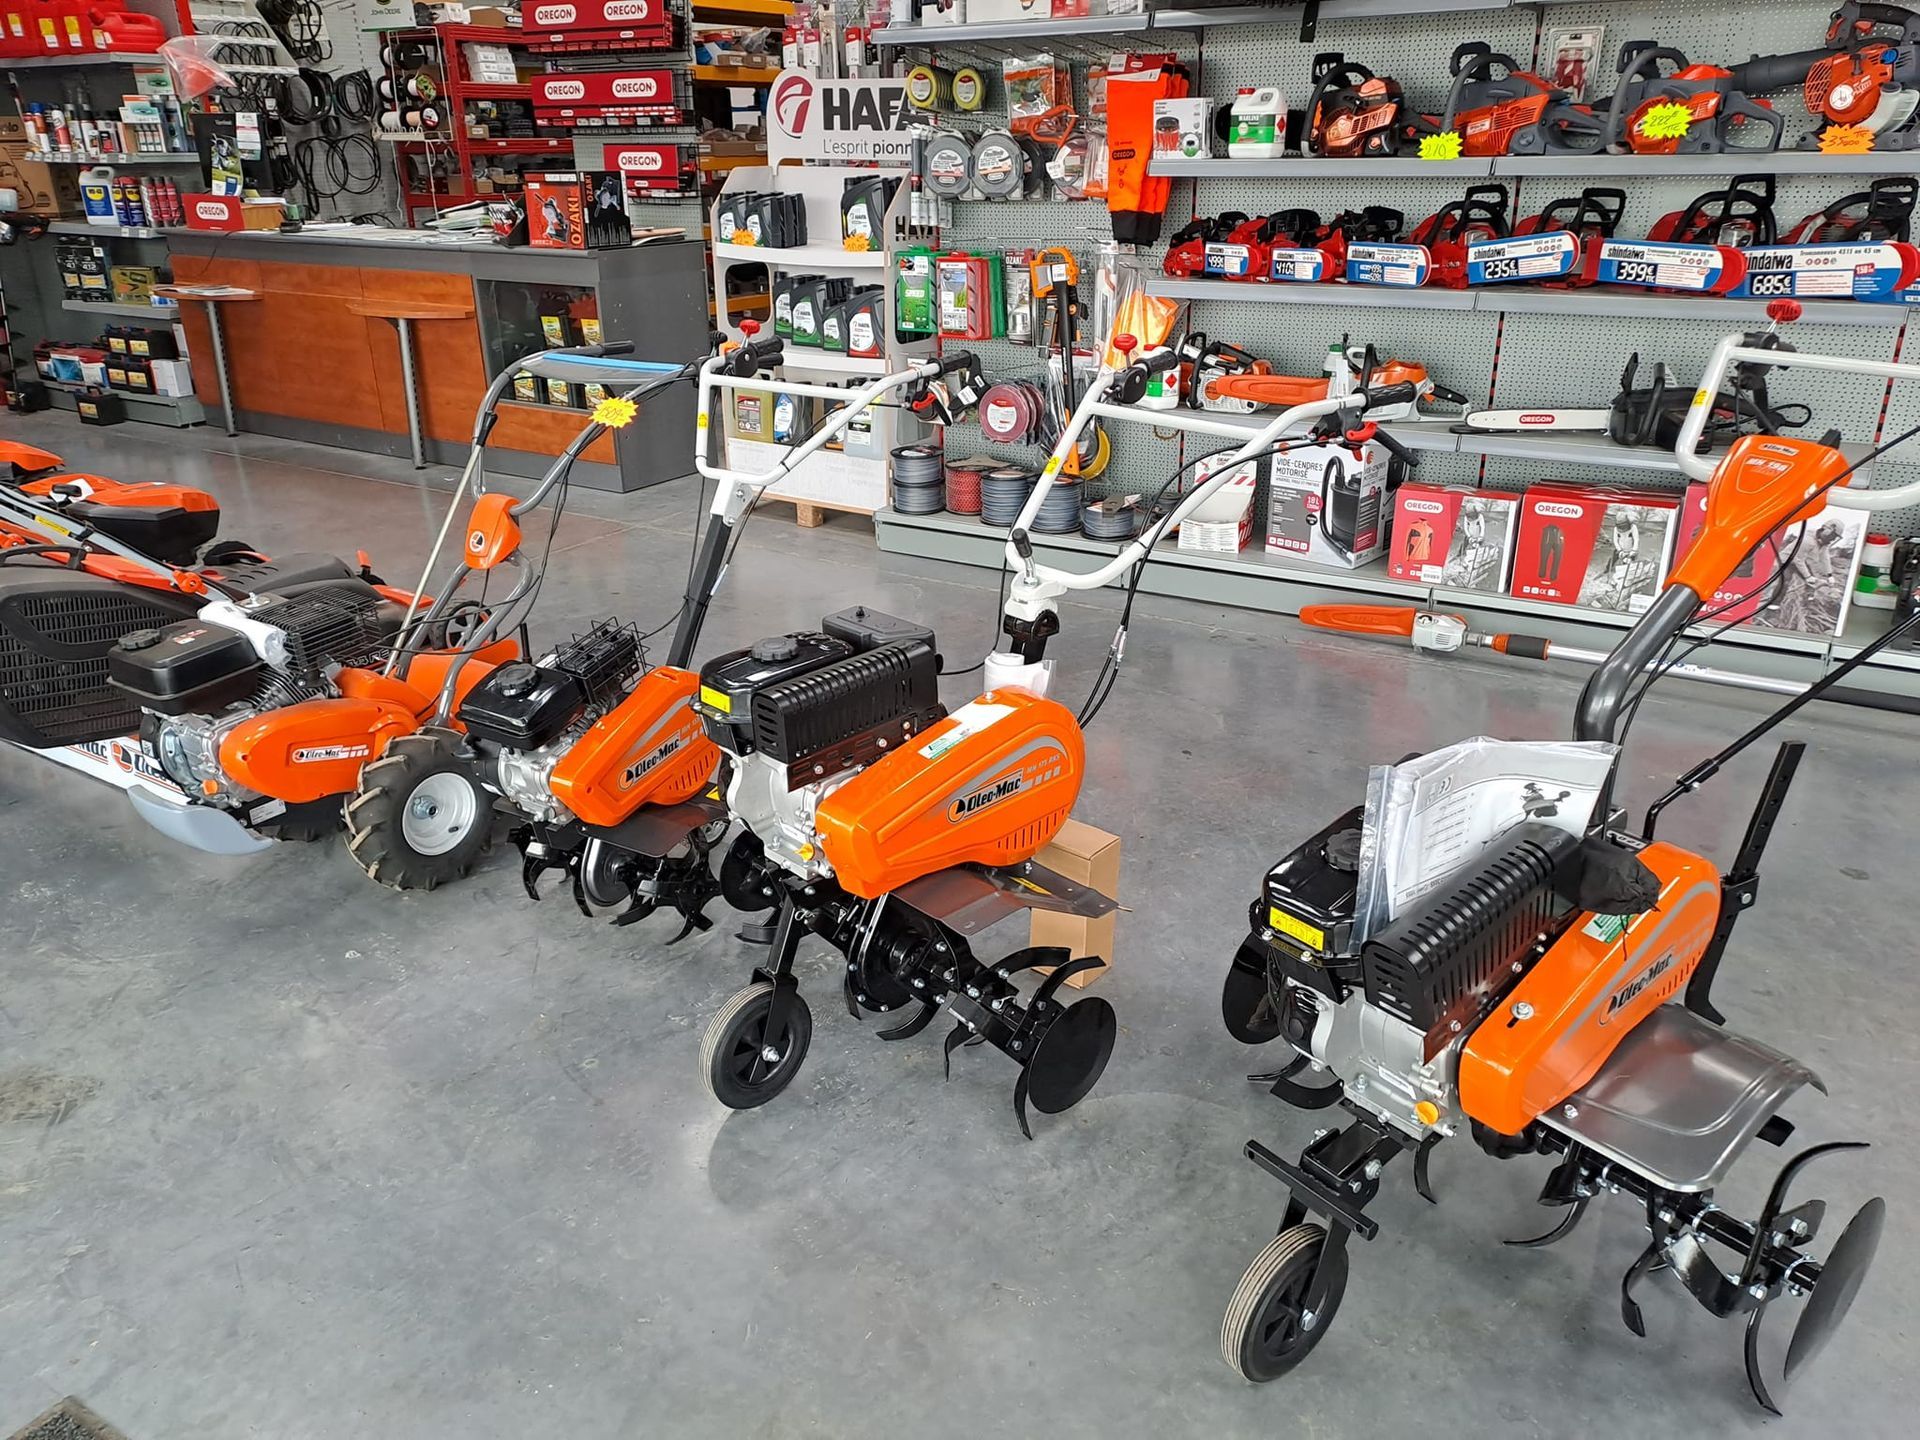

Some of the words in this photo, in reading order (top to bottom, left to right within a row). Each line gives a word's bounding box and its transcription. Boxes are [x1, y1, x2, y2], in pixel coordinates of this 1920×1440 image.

[537, 11, 572, 20] OREGON
[606, 4, 643, 16] OREGON
[546, 84, 580, 95] OREGON
[615, 82, 652, 93] OREGON
[823, 139, 869, 154] L'esprit
[620, 155, 657, 166] OREGON
[198, 205, 226, 216] OREGON
[567, 197, 581, 245] OZAKI
[1474, 246, 1506, 260] shindaiwa
[1607, 246, 1645, 260] shindaiwa
[1276, 457, 1323, 472] VIDE-CENDRES
[1406, 502, 1440, 511] OREGON
[1538, 505, 1578, 515] OREGON
[305, 749, 340, 758] Oleo-Mac
[634, 738, 680, 778] Oleo-Mac
[966, 778, 1021, 812] Oleo-Mac
[1617, 953, 1672, 1008] Oleo-Mac
